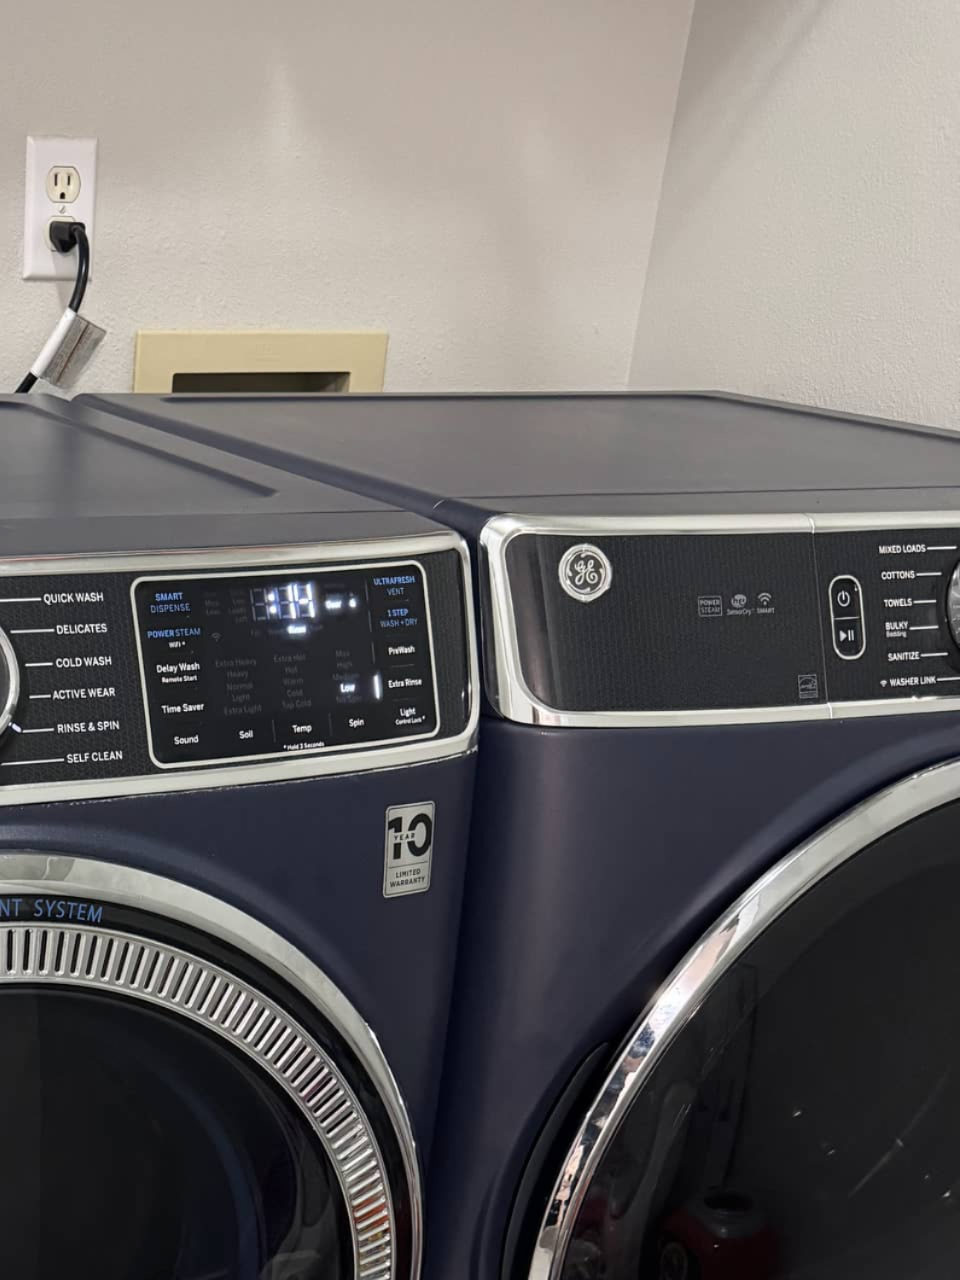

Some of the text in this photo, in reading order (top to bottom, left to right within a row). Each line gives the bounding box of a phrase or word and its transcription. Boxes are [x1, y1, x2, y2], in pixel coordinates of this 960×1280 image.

[879, 544, 926, 554] MIXED LOADS
[881, 570, 915, 580] COTTONS
[373, 575, 415, 586] ULTRAFRESH
[155, 591, 183, 602] SMART
[387, 587, 405, 596] VENT
[43, 591, 104, 605] QUICK WASH
[883, 598, 912, 608] TOWELS
[150, 602, 191, 614] DISPENSE
[392, 608, 409, 617] STEP
[56, 623, 107, 634] DELICATES
[380, 619, 400, 628] WASH
[885, 621, 908, 630] BULKY
[147, 629, 174, 639] POWER
[388, 645, 415, 655] PreWash
[888, 651, 920, 661] SANITIZE
[56, 655, 112, 668] COLD WASH
[156, 661, 200, 674] Delay Wash
[388, 678, 422, 689] Extra Rinse
[889, 676, 936, 687] WASHER LINK
[340, 683, 356, 693] Low
[52, 687, 116, 700] ACTIVE WEAR
[161, 703, 204, 714] Time Saver
[400, 707, 416, 717] Light
[57, 720, 120, 733] RINSE & SPIN
[348, 718, 365, 728] Spin
[292, 724, 312, 733] Temp
[239, 729, 254, 739] Soil
[173, 734, 199, 745] Sound
[66, 750, 123, 764] SELF CLEAN
[388, 812, 432, 860] 10
[394, 832, 415, 841] YEAR
[395, 868, 421, 878] LIMITED
[389, 876, 425, 888] WARRANTY
[33, 899, 103, 924] SYSTEM
